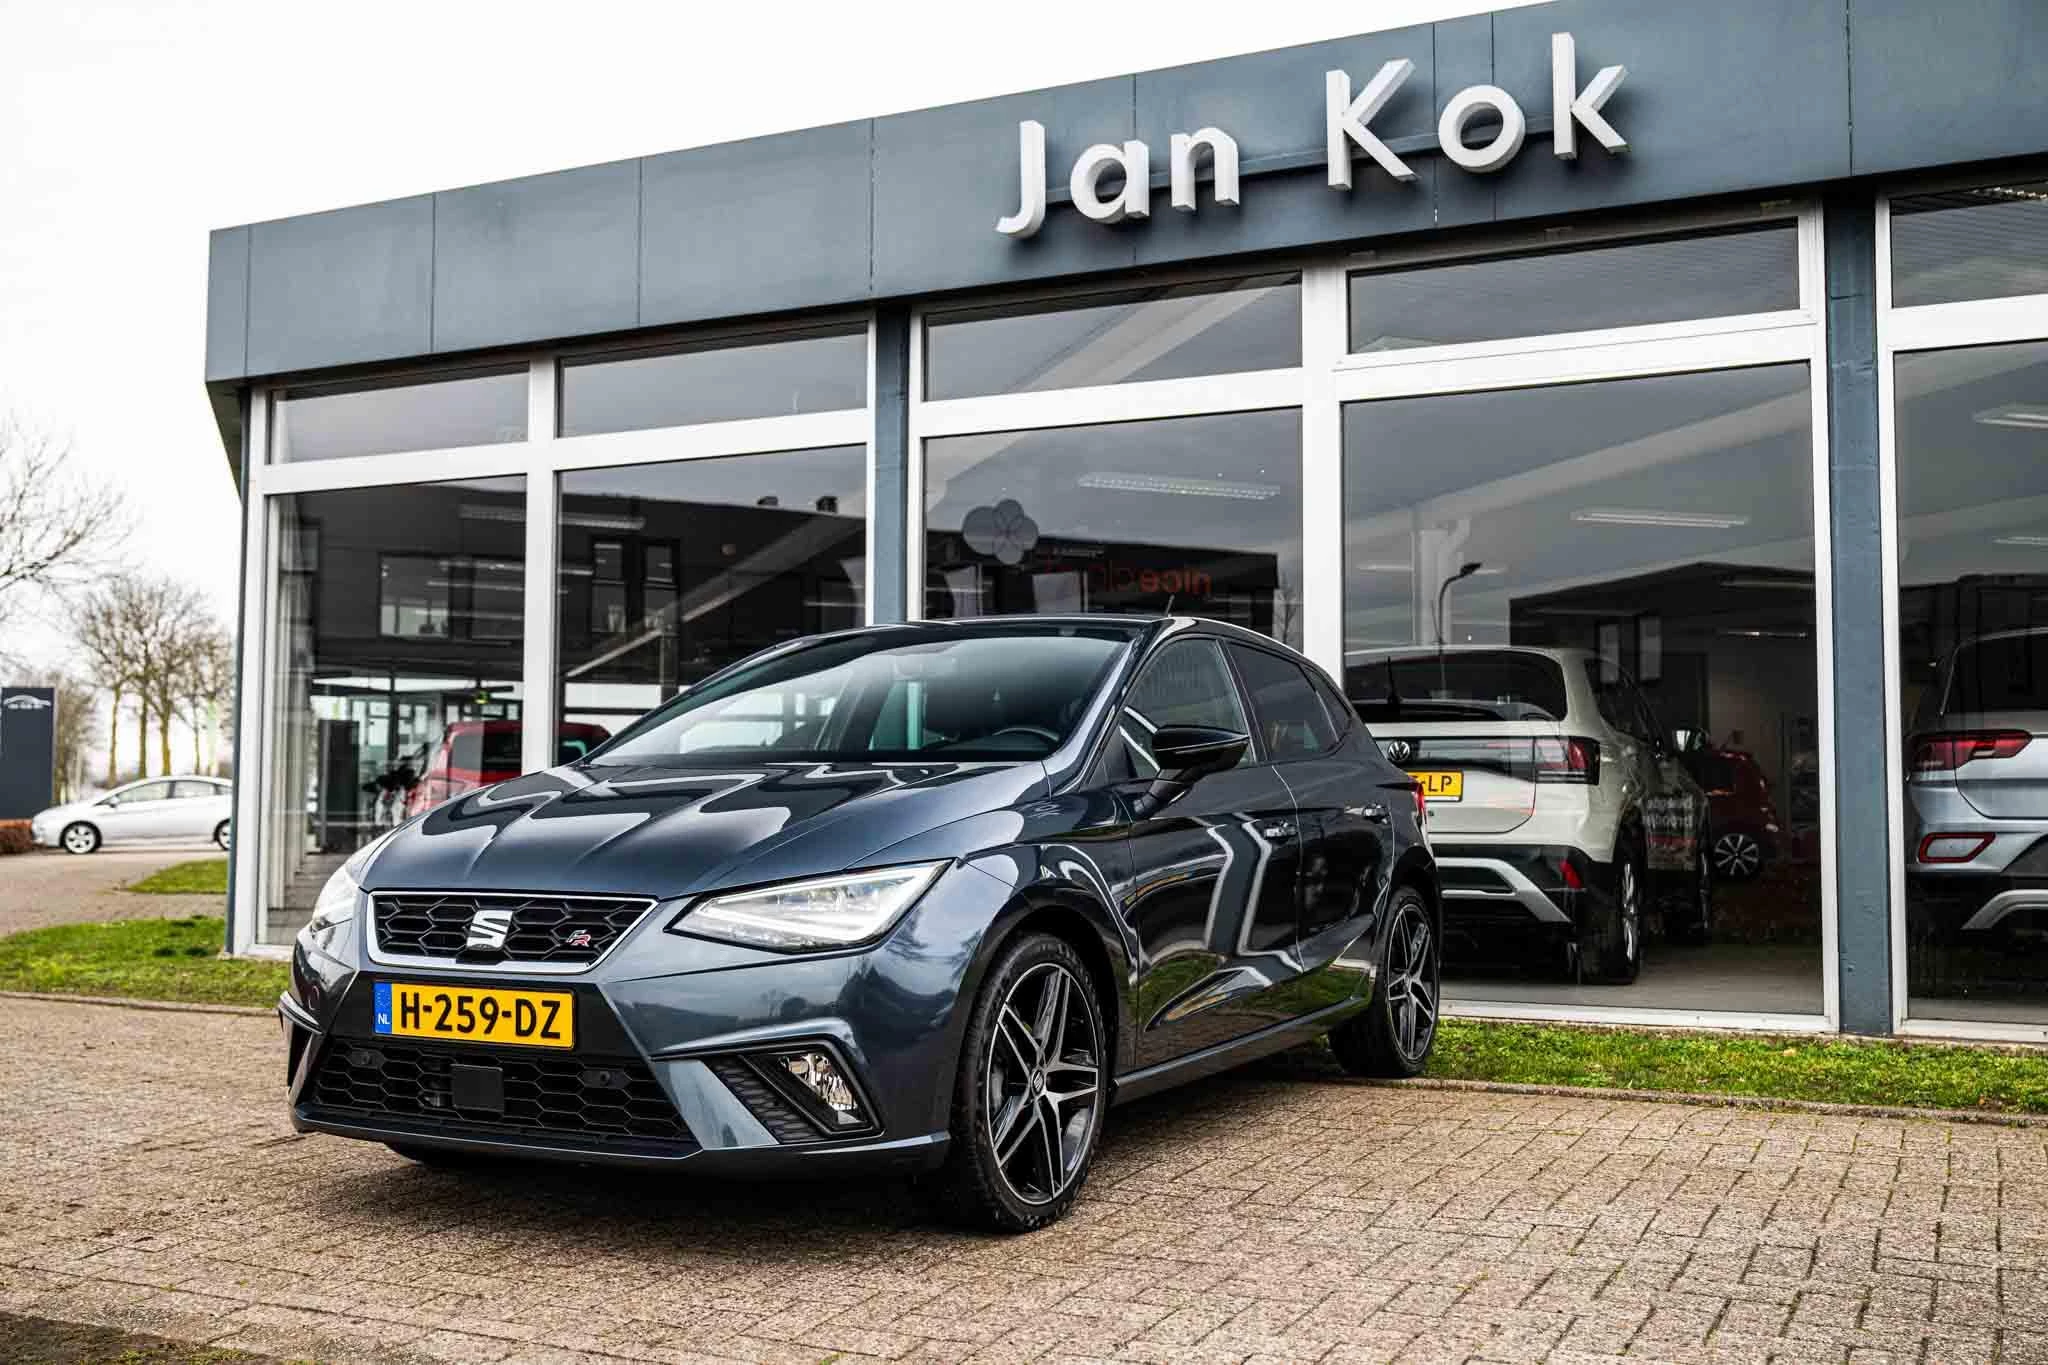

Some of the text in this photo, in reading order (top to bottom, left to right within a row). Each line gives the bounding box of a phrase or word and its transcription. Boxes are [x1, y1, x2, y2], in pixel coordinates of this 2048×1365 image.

[996, 32, 1632, 240] Jan Kok
[377, 992, 561, 1039] NL H-259-DZ
